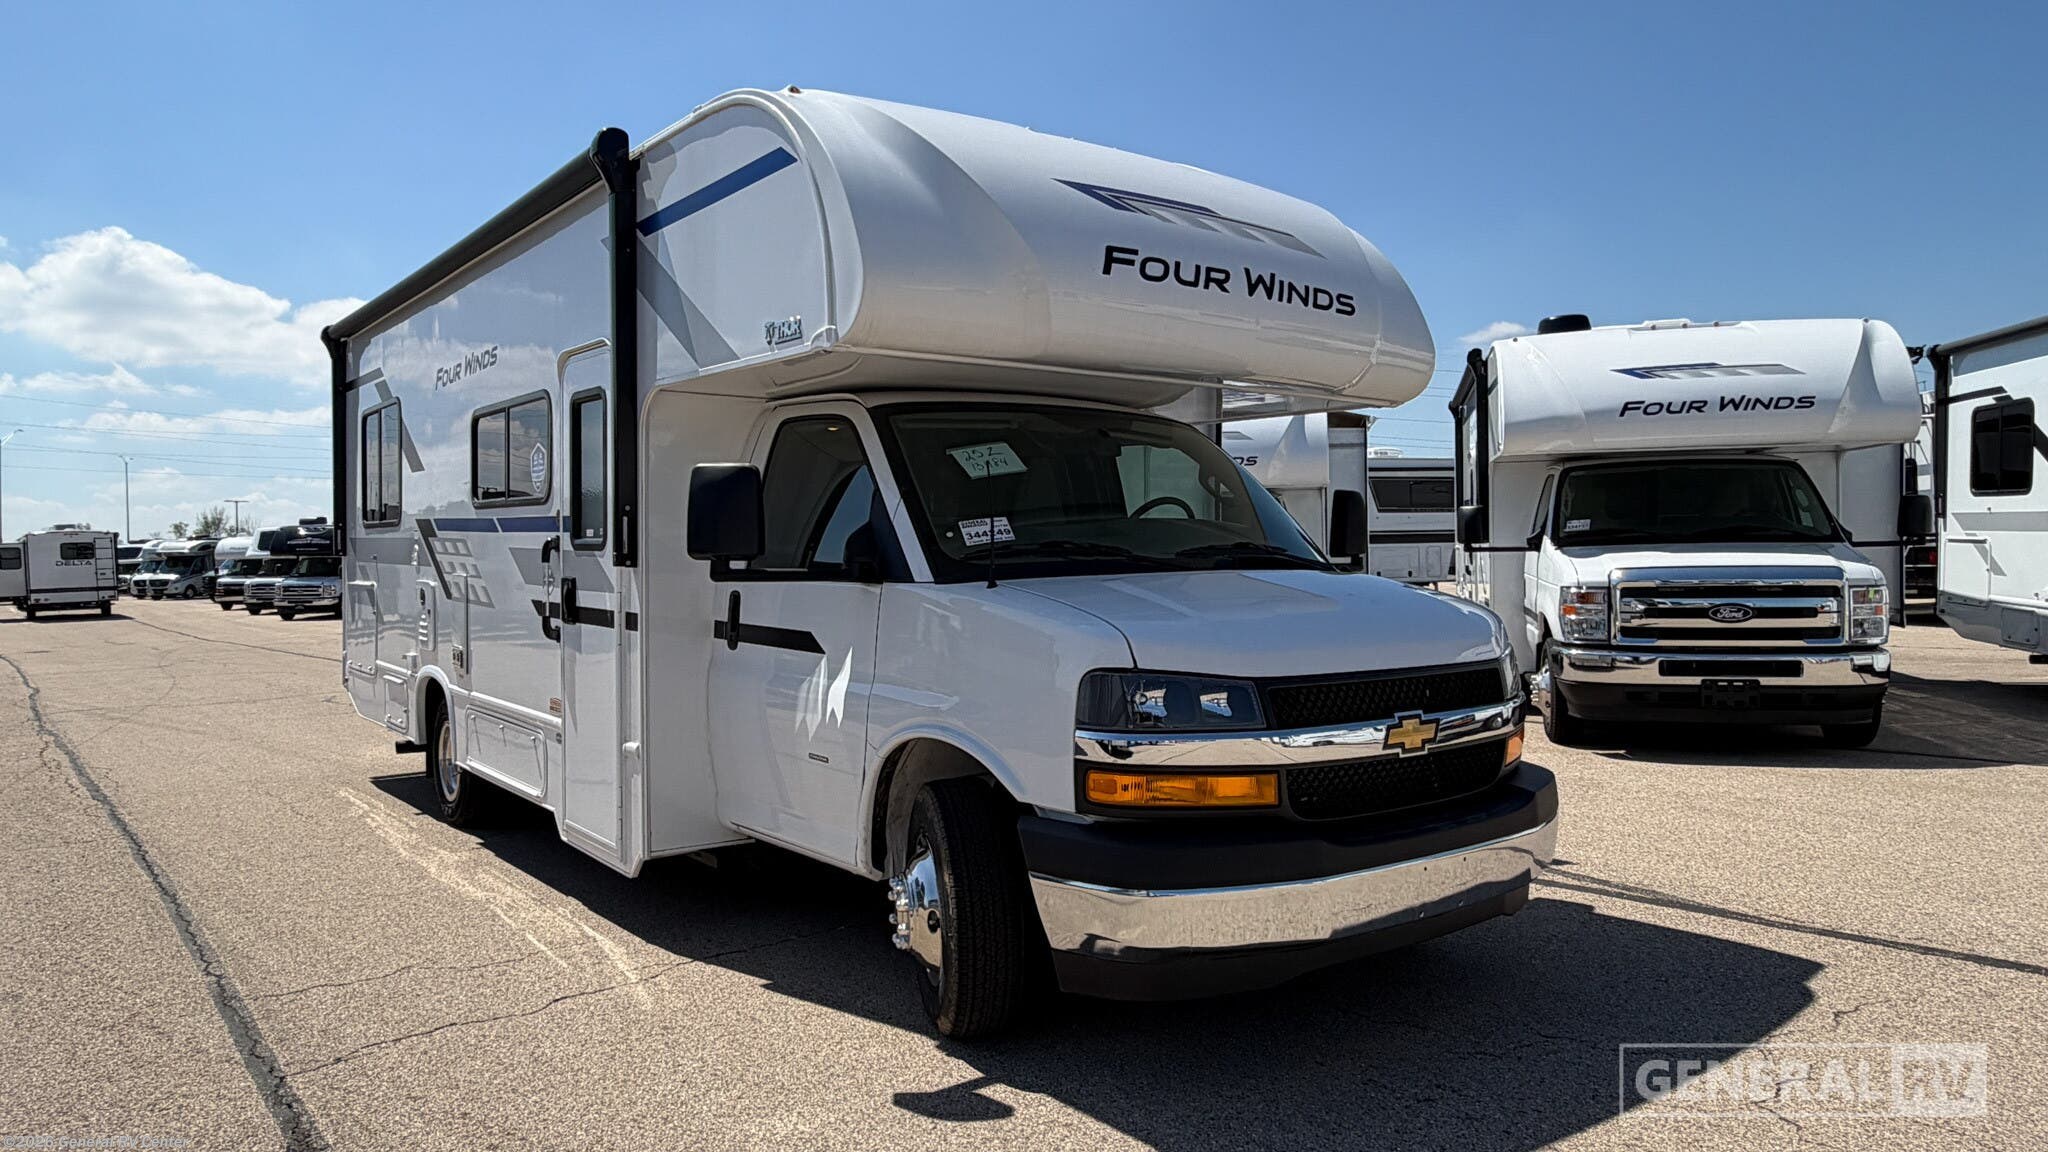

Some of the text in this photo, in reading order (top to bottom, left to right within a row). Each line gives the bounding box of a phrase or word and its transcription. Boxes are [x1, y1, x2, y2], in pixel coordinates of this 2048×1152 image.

[1102, 245, 1356, 316] FOUR WINDS
[435, 345, 498, 391] FOUR WINDS
[1619, 395, 1816, 417] FOUR WINDS
[1716, 607, 1744, 618] Ford
